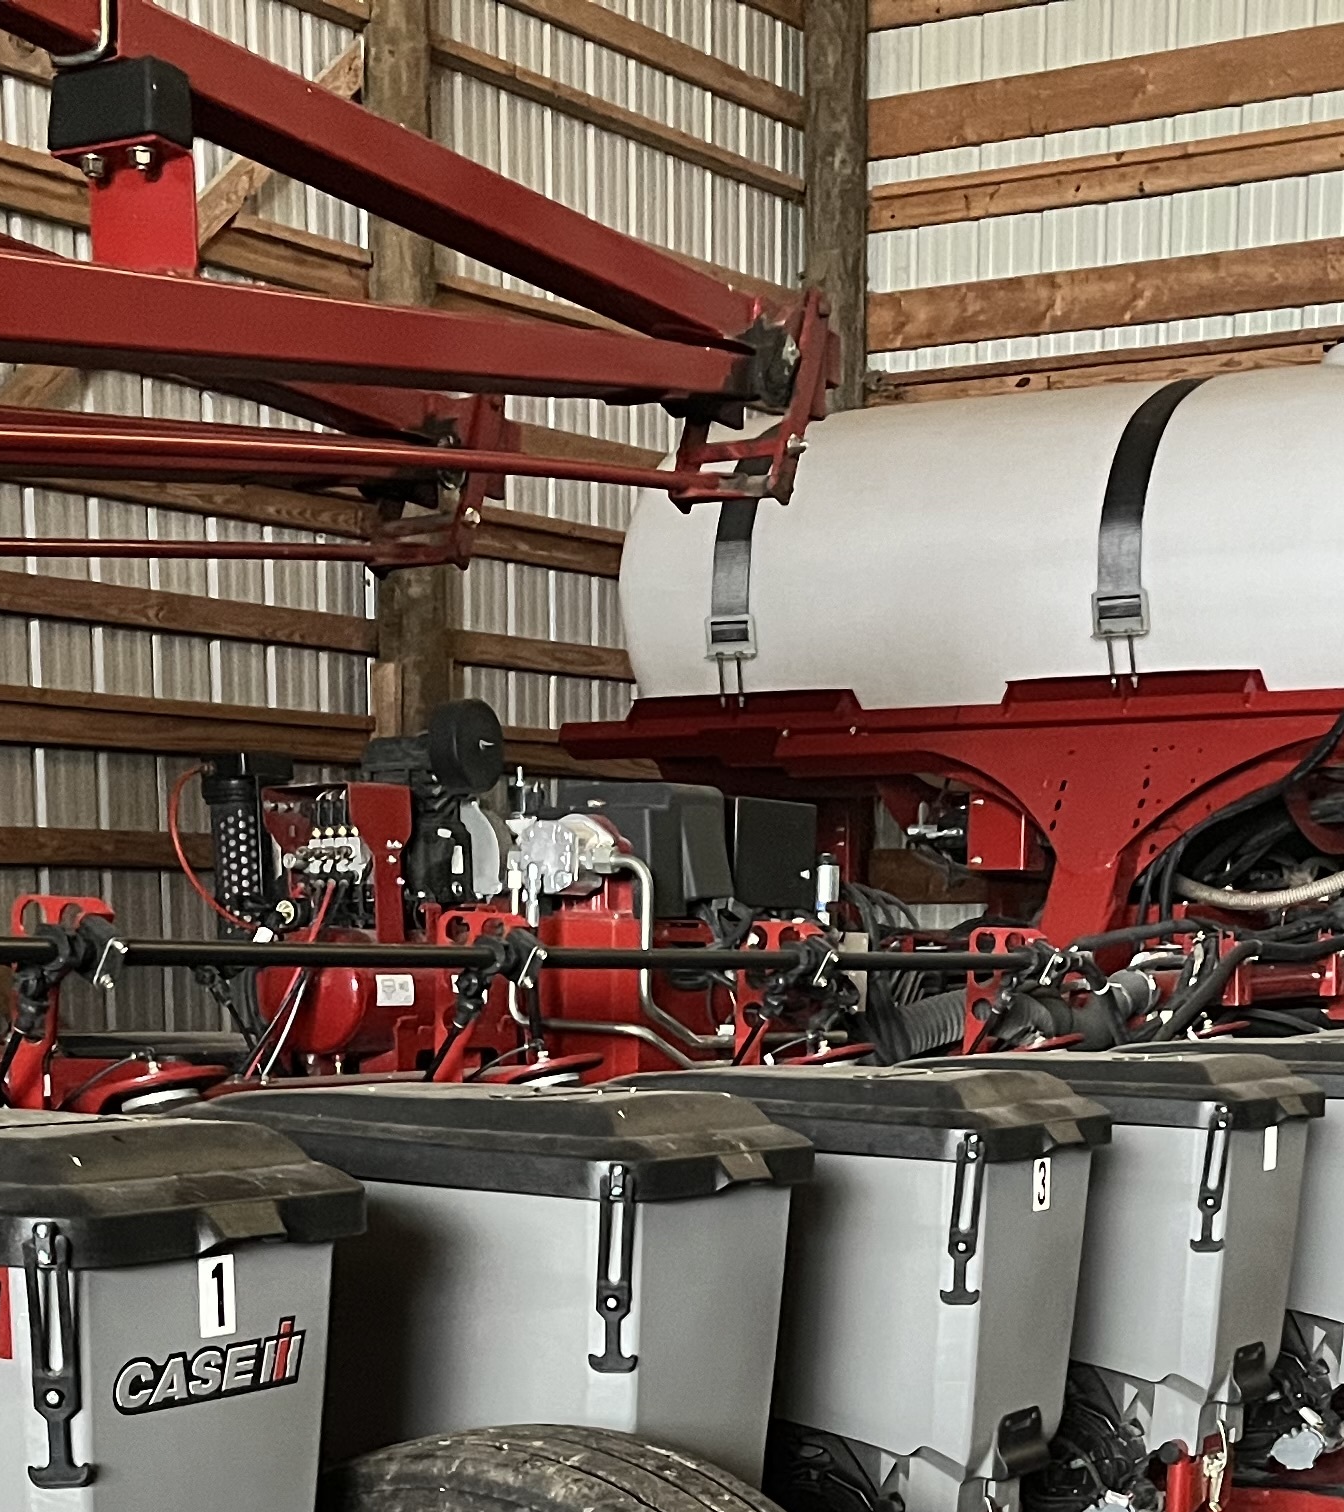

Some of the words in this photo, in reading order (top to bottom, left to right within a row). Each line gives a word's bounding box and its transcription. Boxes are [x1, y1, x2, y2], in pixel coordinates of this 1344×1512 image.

[1037, 1160, 1047, 1206] 3
[211, 1262, 226, 1328] 1
[115, 1343, 258, 1409] CASE
